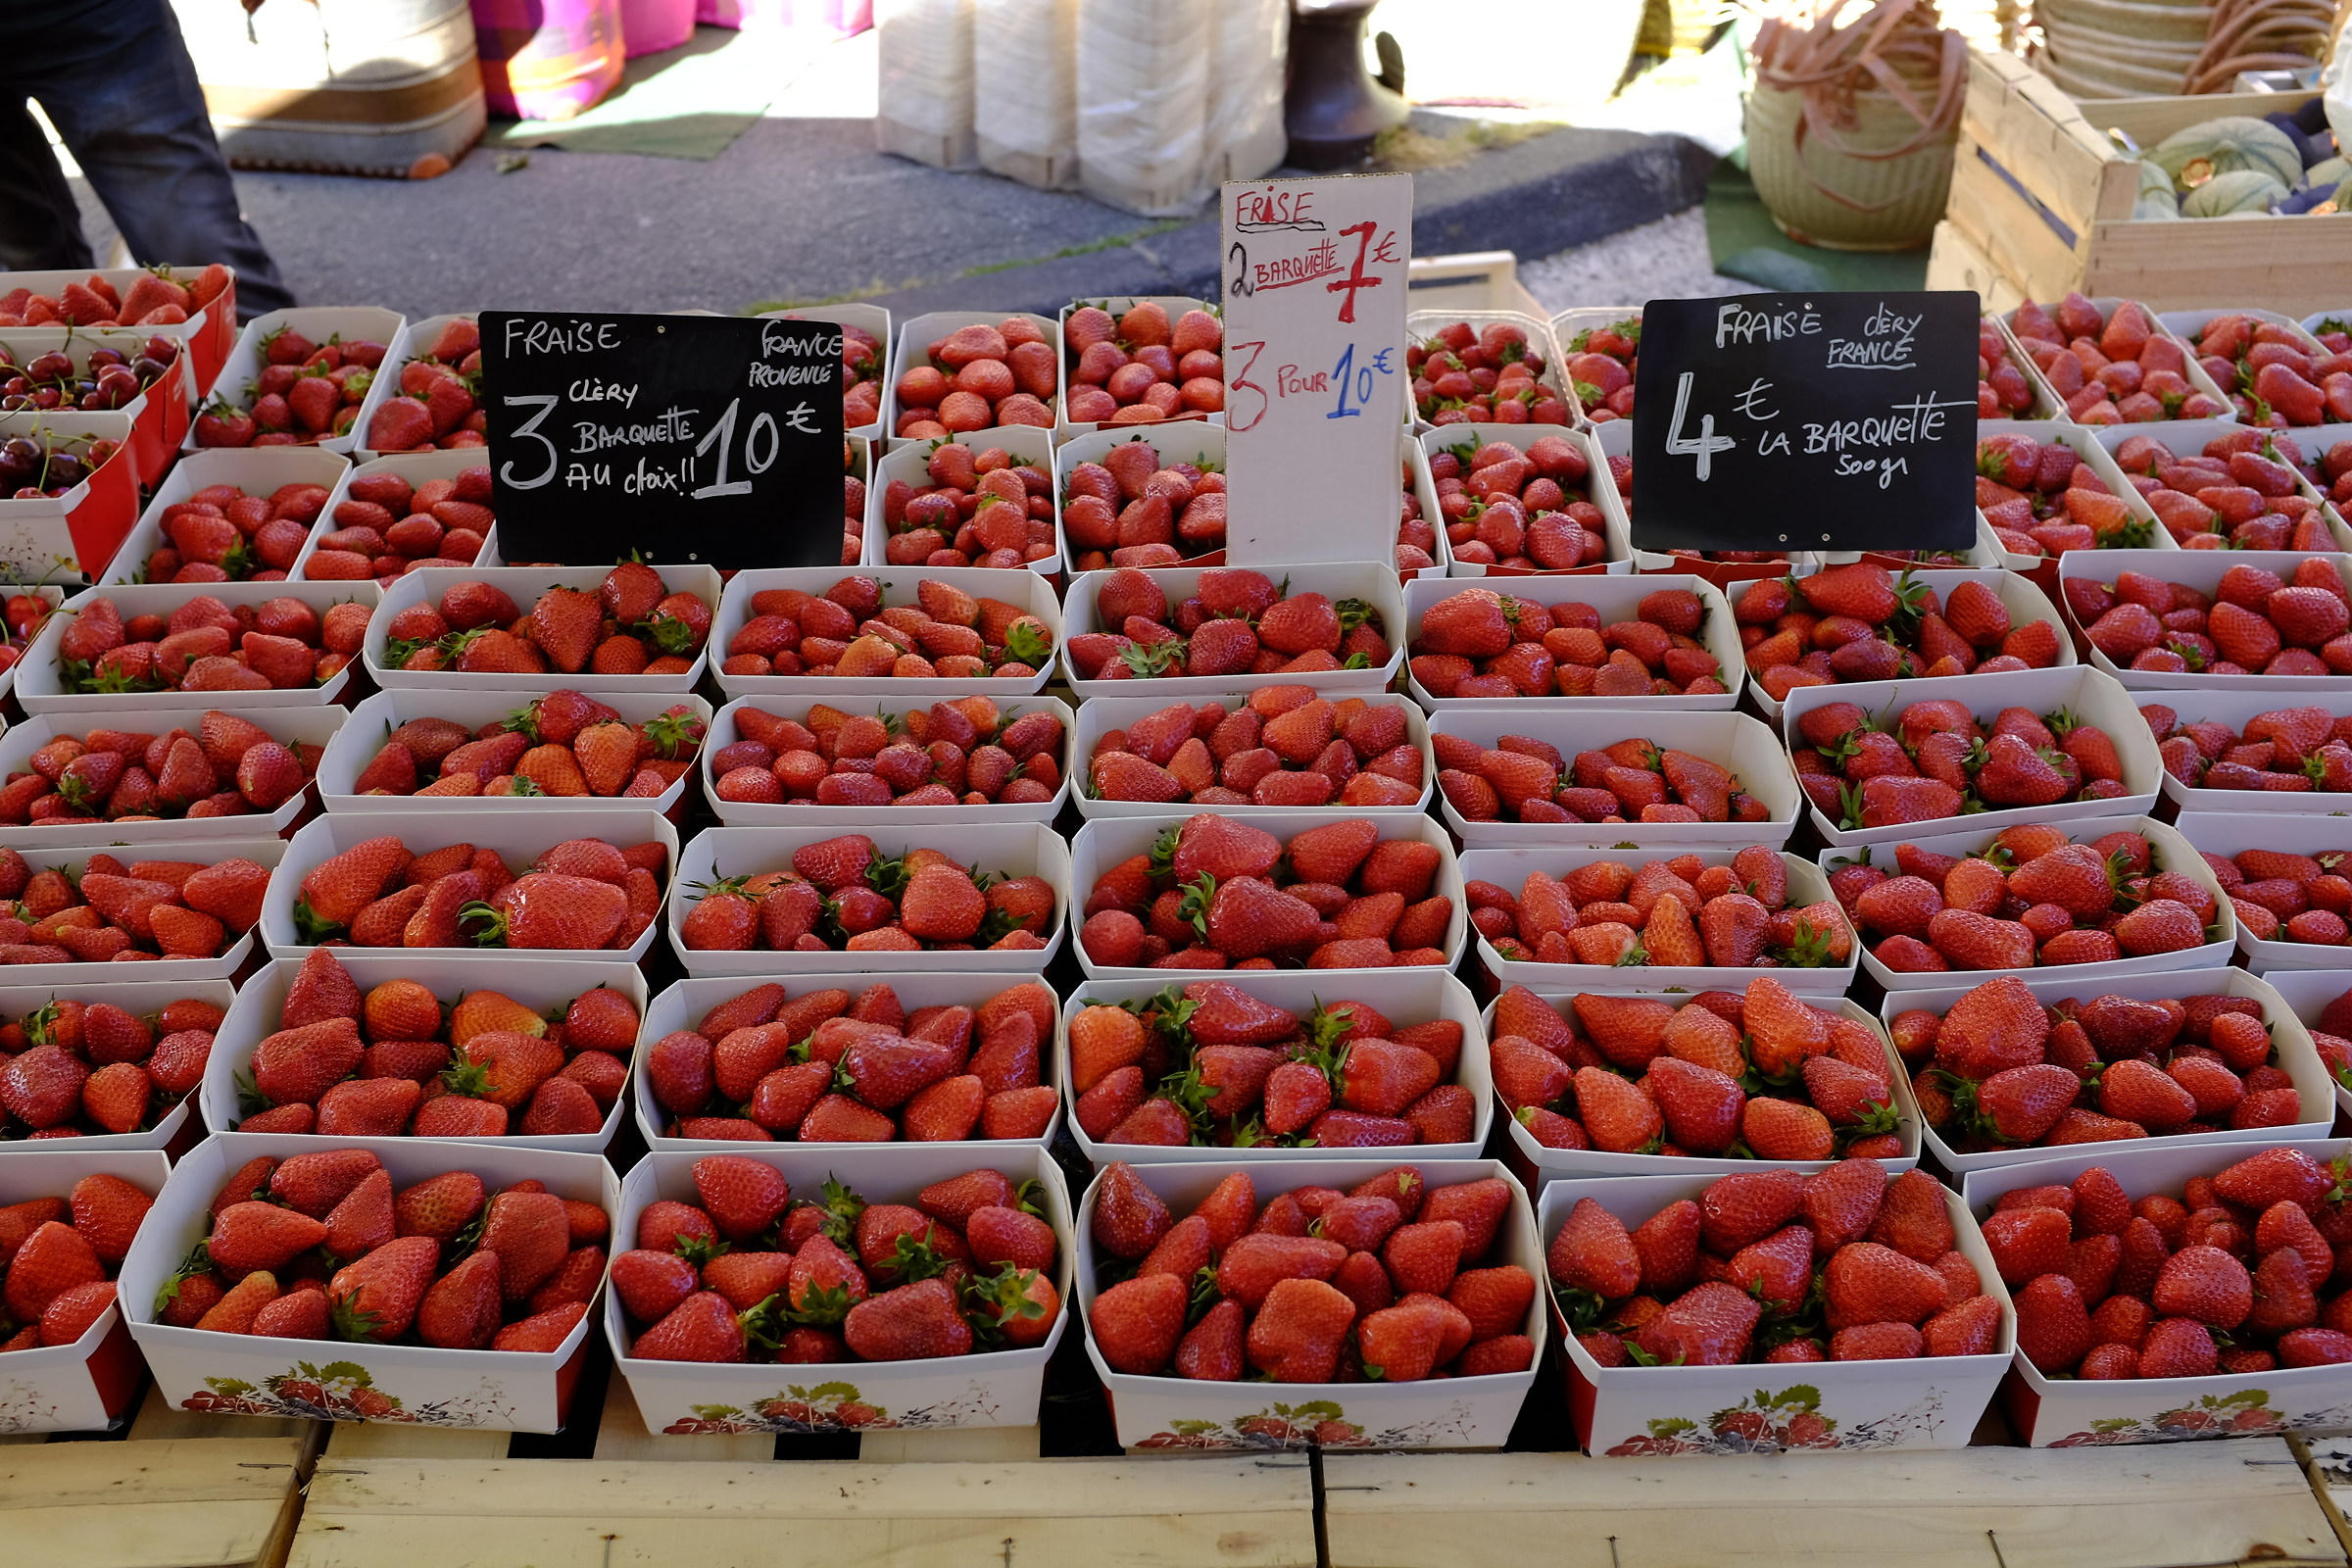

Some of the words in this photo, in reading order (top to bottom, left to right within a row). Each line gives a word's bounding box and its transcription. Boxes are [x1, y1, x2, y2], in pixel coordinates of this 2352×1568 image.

[1229, 241, 1254, 298] 2
[761, 318, 844, 359] FRANCE
[1827, 337, 1916, 367] FRANCE
[1227, 341, 1269, 432] 3
[500, 395, 560, 491] 3
[564, 463, 611, 491] AU
